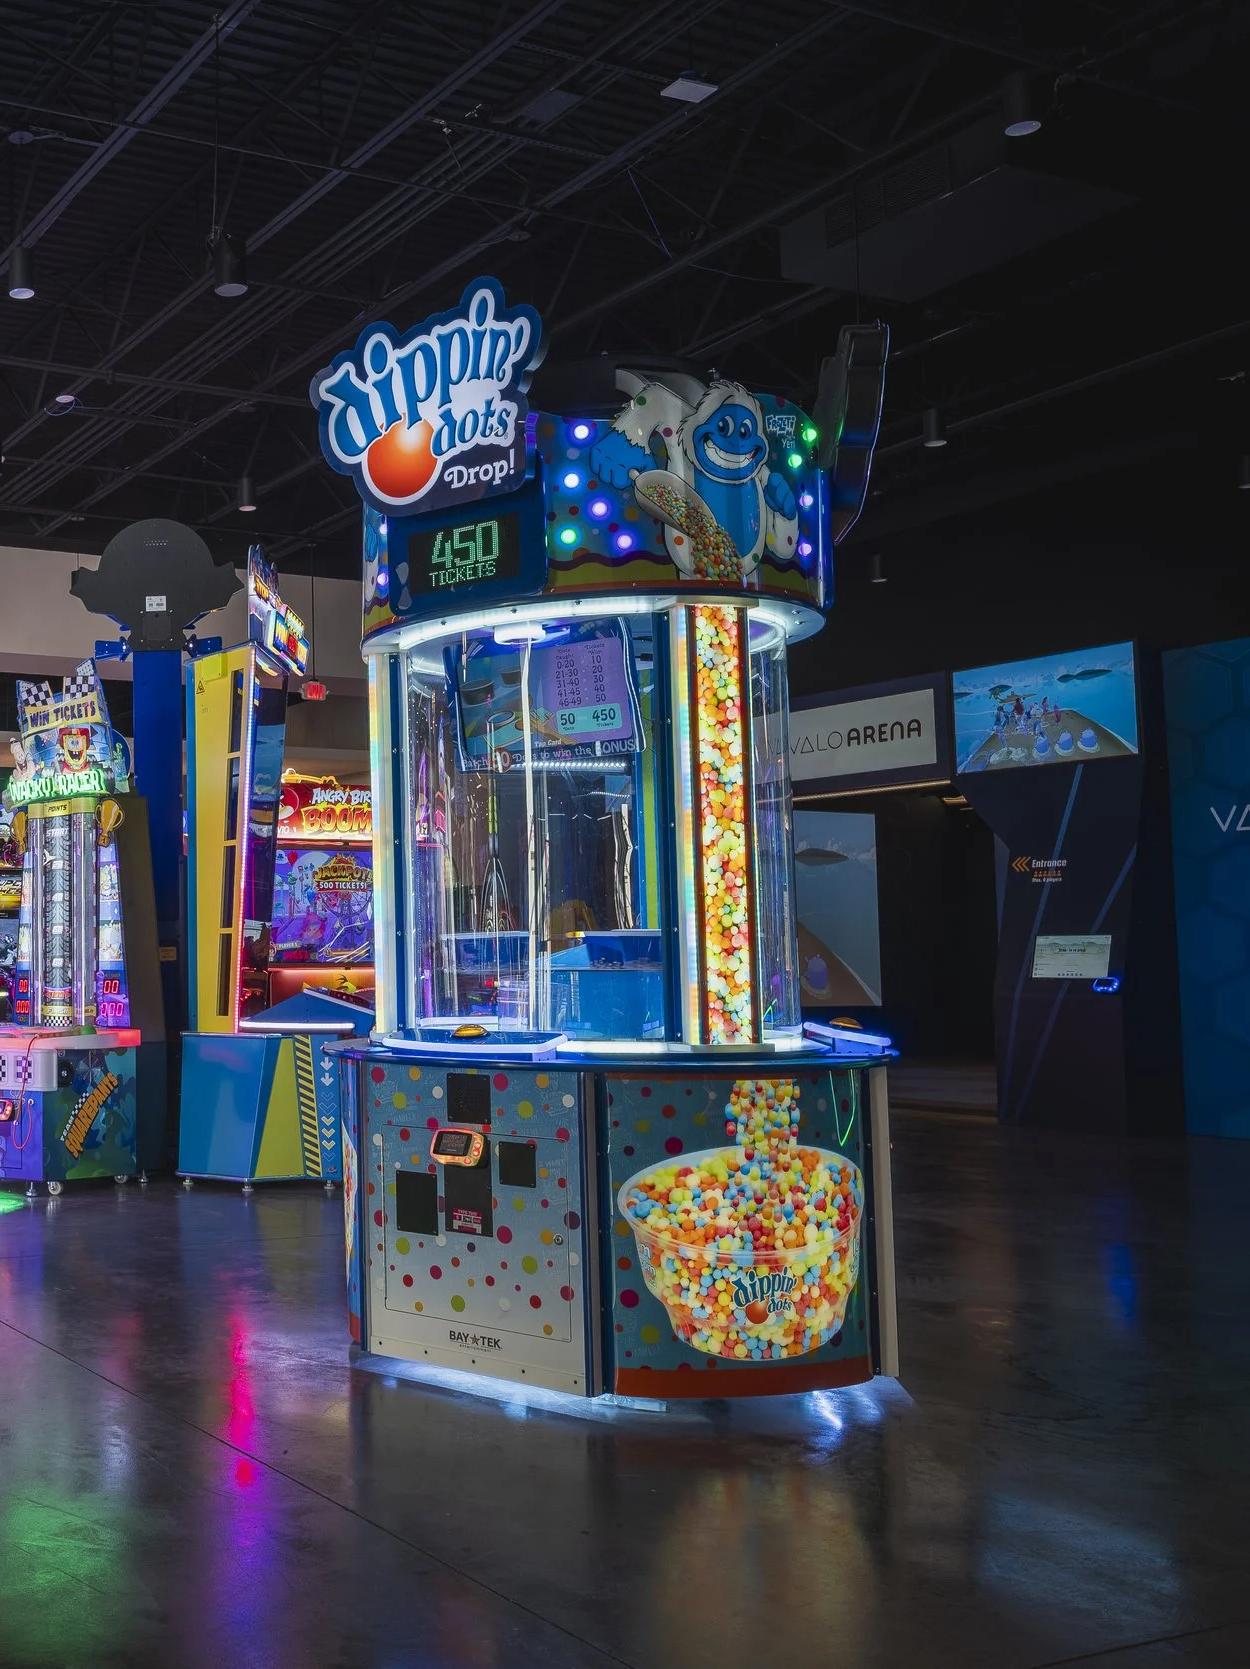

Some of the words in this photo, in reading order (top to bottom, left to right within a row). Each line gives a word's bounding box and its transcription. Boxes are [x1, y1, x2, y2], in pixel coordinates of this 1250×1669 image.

[324, 296, 524, 457] dippin'
[433, 397, 511, 456] dots
[444, 449, 515, 489] Drop!
[431, 520, 499, 569] 450
[429, 561, 497, 587] TICKETS
[592, 655, 602, 664] 10
[592, 664, 603, 674] 20
[593, 674, 604, 683] 30
[594, 684, 605, 693] 40
[595, 693, 606, 702] 50
[53, 700, 96, 722] TICKETS
[560, 712, 576, 726] 50
[592, 707, 616, 722] 450
[57, 768, 107, 796] RACER
[311, 788, 349, 805] ANGRY
[47, 804, 67, 813] POINTS
[46, 828, 70, 837] START
[1031, 859, 1067, 868] Entrance
[319, 881, 334, 890] 500
[335, 881, 367, 890] TICKETS!
[103, 980, 120, 994] 00
[64, 1072, 120, 1160] SQUAREPANTS
[767, 1296, 793, 1314] dots
[449, 1330, 469, 1343] BAY
[480, 1335, 501, 1349] TEK
